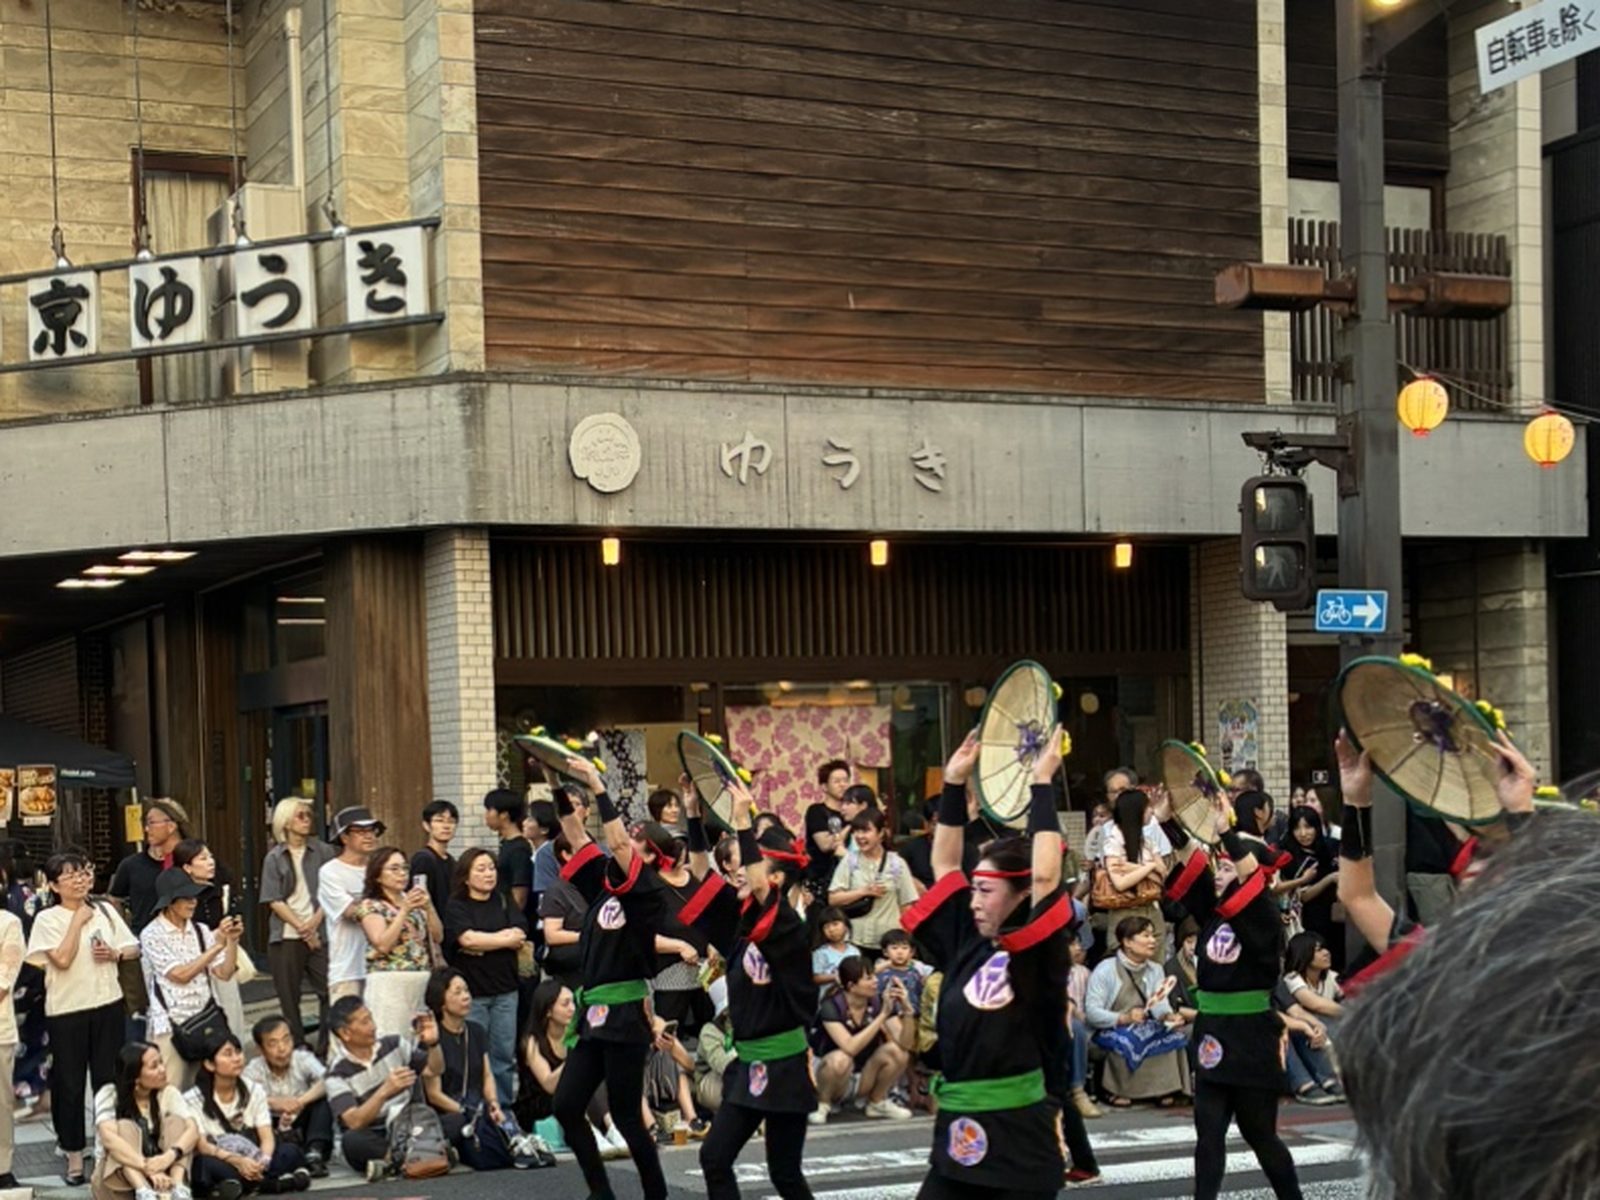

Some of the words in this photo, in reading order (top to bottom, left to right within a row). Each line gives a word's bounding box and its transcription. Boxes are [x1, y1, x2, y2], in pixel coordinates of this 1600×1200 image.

[1487, 3, 1597, 75] 自転車を除く
[30, 240, 408, 356] 京ゆうき
[720, 430, 947, 492] ゆうき
